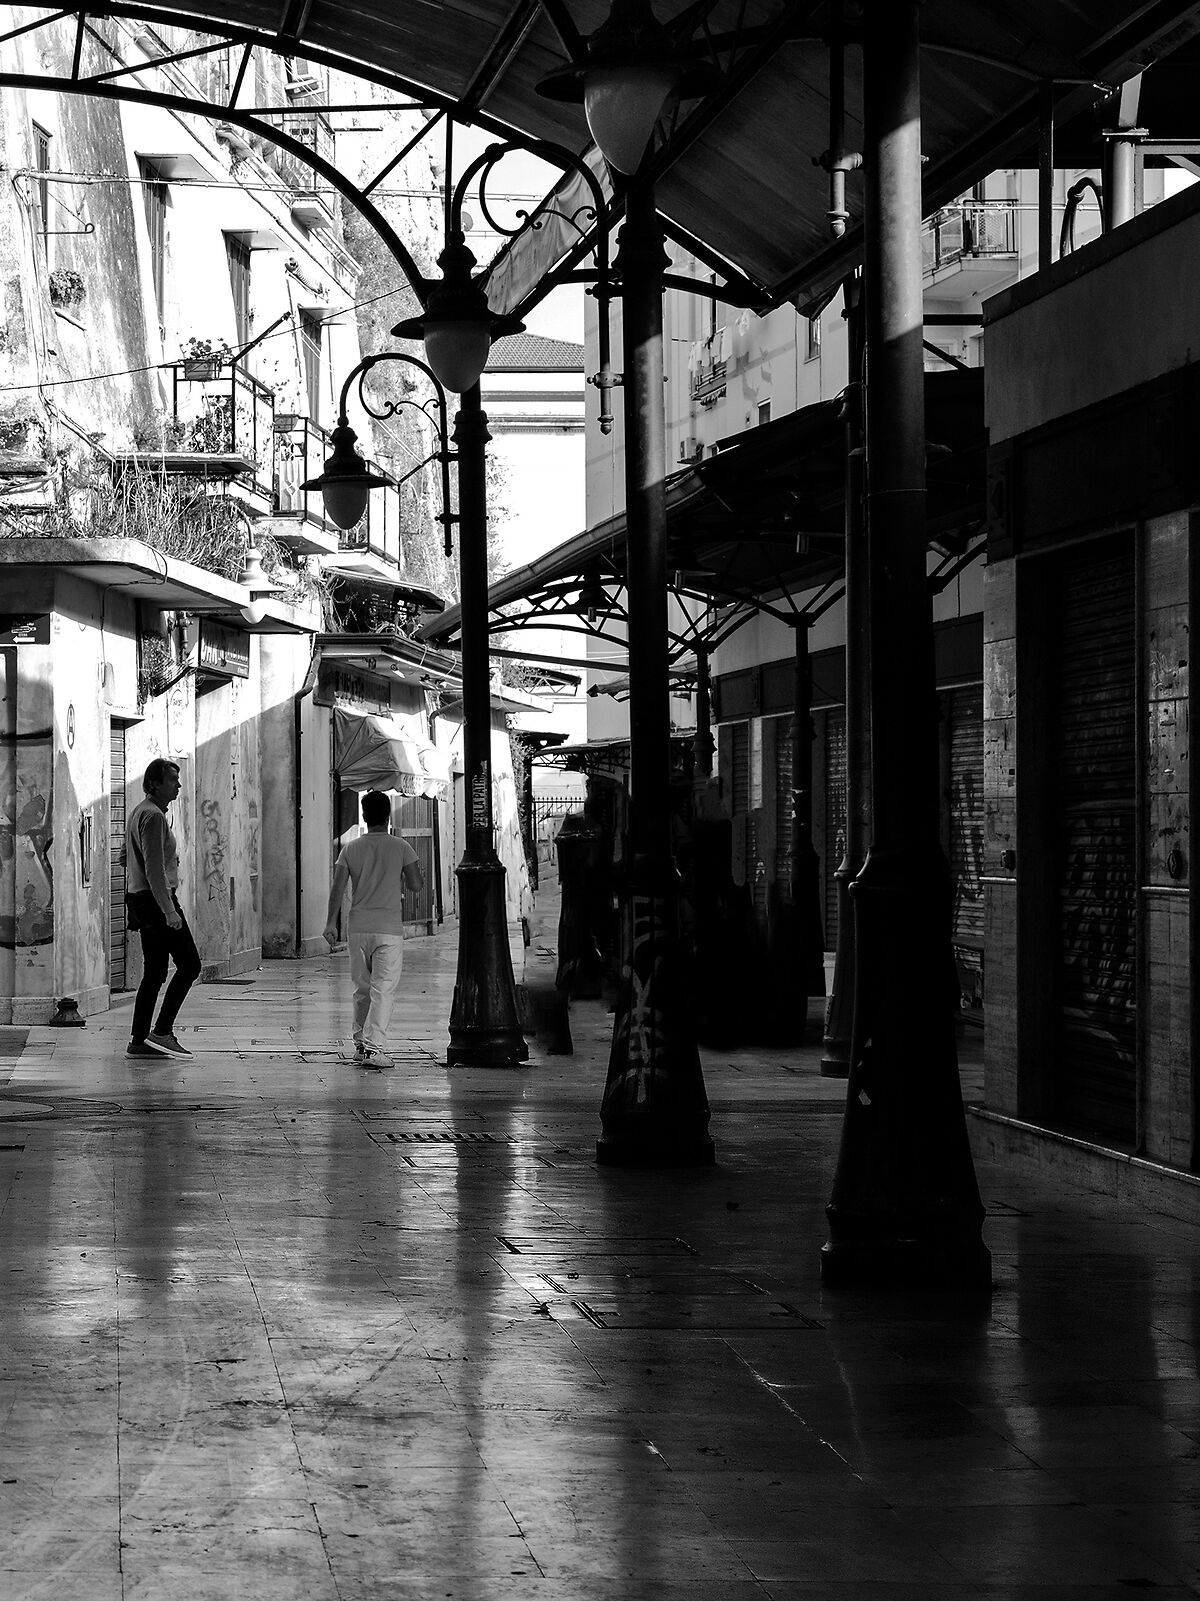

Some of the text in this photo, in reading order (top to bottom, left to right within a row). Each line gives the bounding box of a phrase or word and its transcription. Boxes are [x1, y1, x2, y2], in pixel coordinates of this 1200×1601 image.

[473, 773, 485, 828] PER LA PATRI
